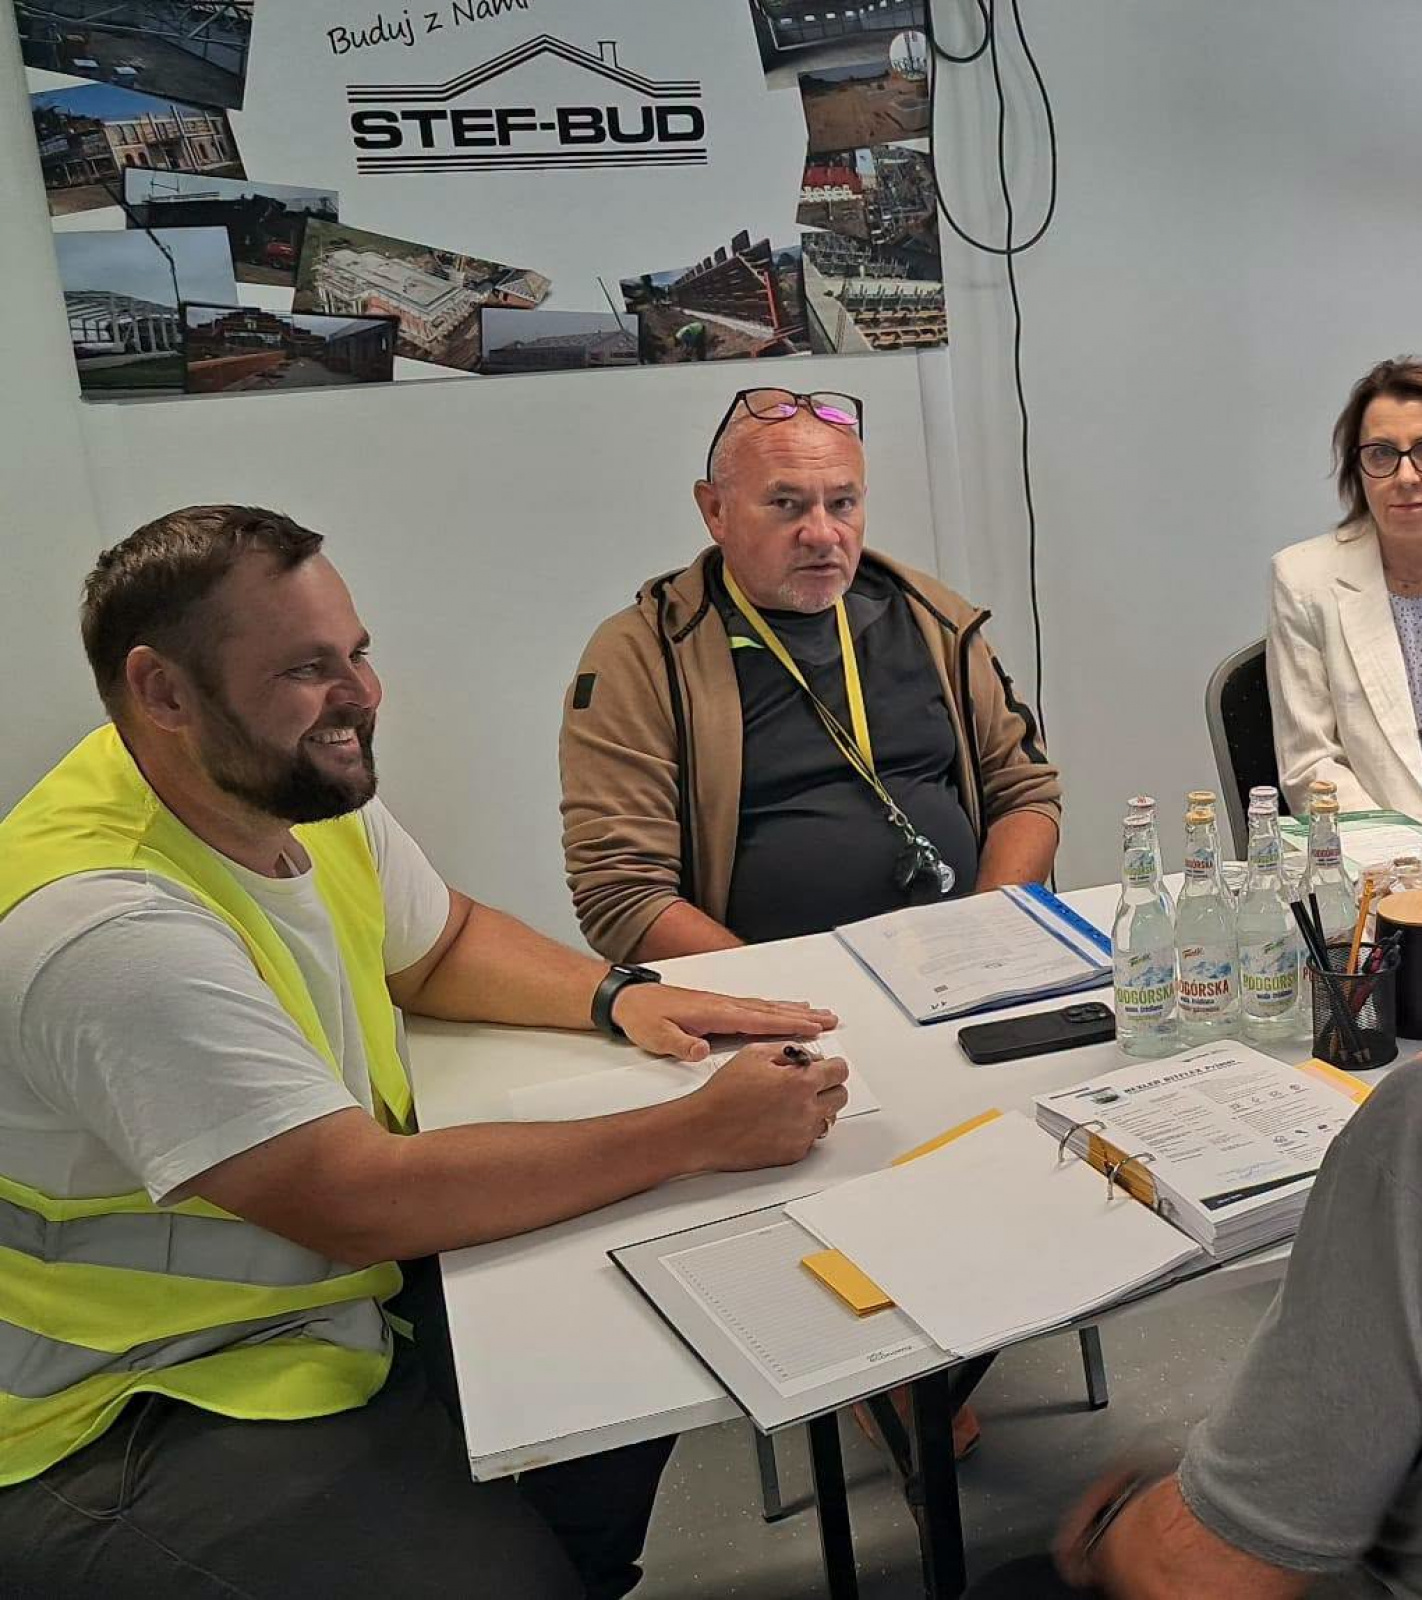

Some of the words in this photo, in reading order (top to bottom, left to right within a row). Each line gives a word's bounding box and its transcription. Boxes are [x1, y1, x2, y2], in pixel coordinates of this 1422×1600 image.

[327, 9, 415, 54] Buduj
[423, 11, 444, 34] z
[350, 105, 705, 149] STEF-BUD
